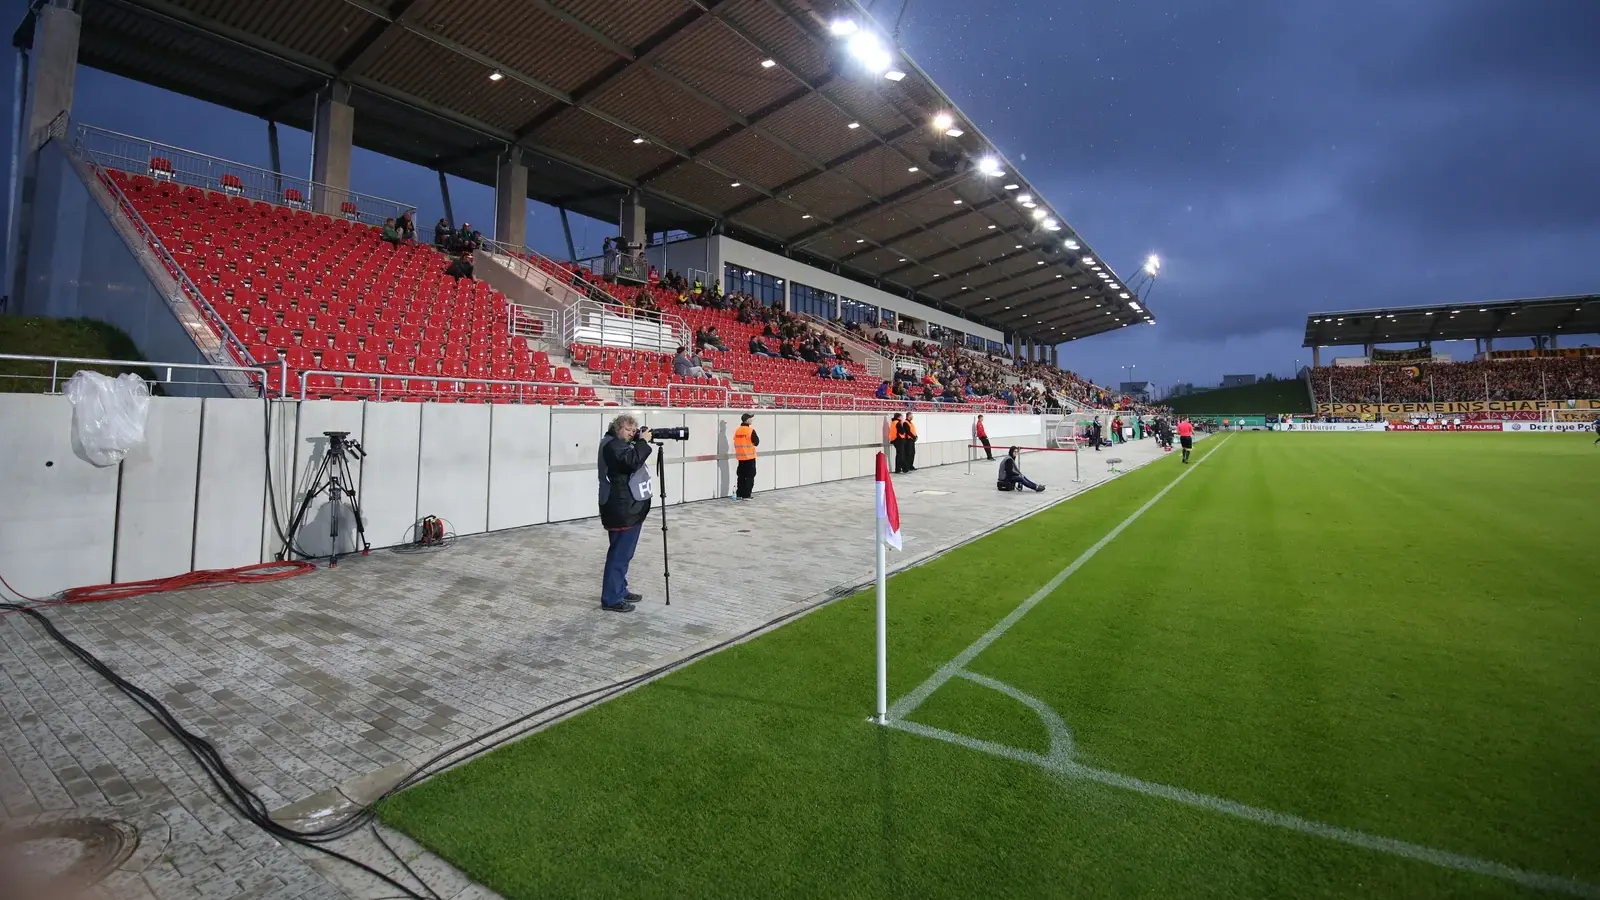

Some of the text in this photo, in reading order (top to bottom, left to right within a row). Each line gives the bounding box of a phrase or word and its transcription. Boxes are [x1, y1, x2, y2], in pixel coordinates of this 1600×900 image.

[1319, 401, 1566, 413] SPORTGEMEINSCHAFT
[1301, 423, 1337, 431] Bitburger
[1529, 423, 1547, 431] Der
